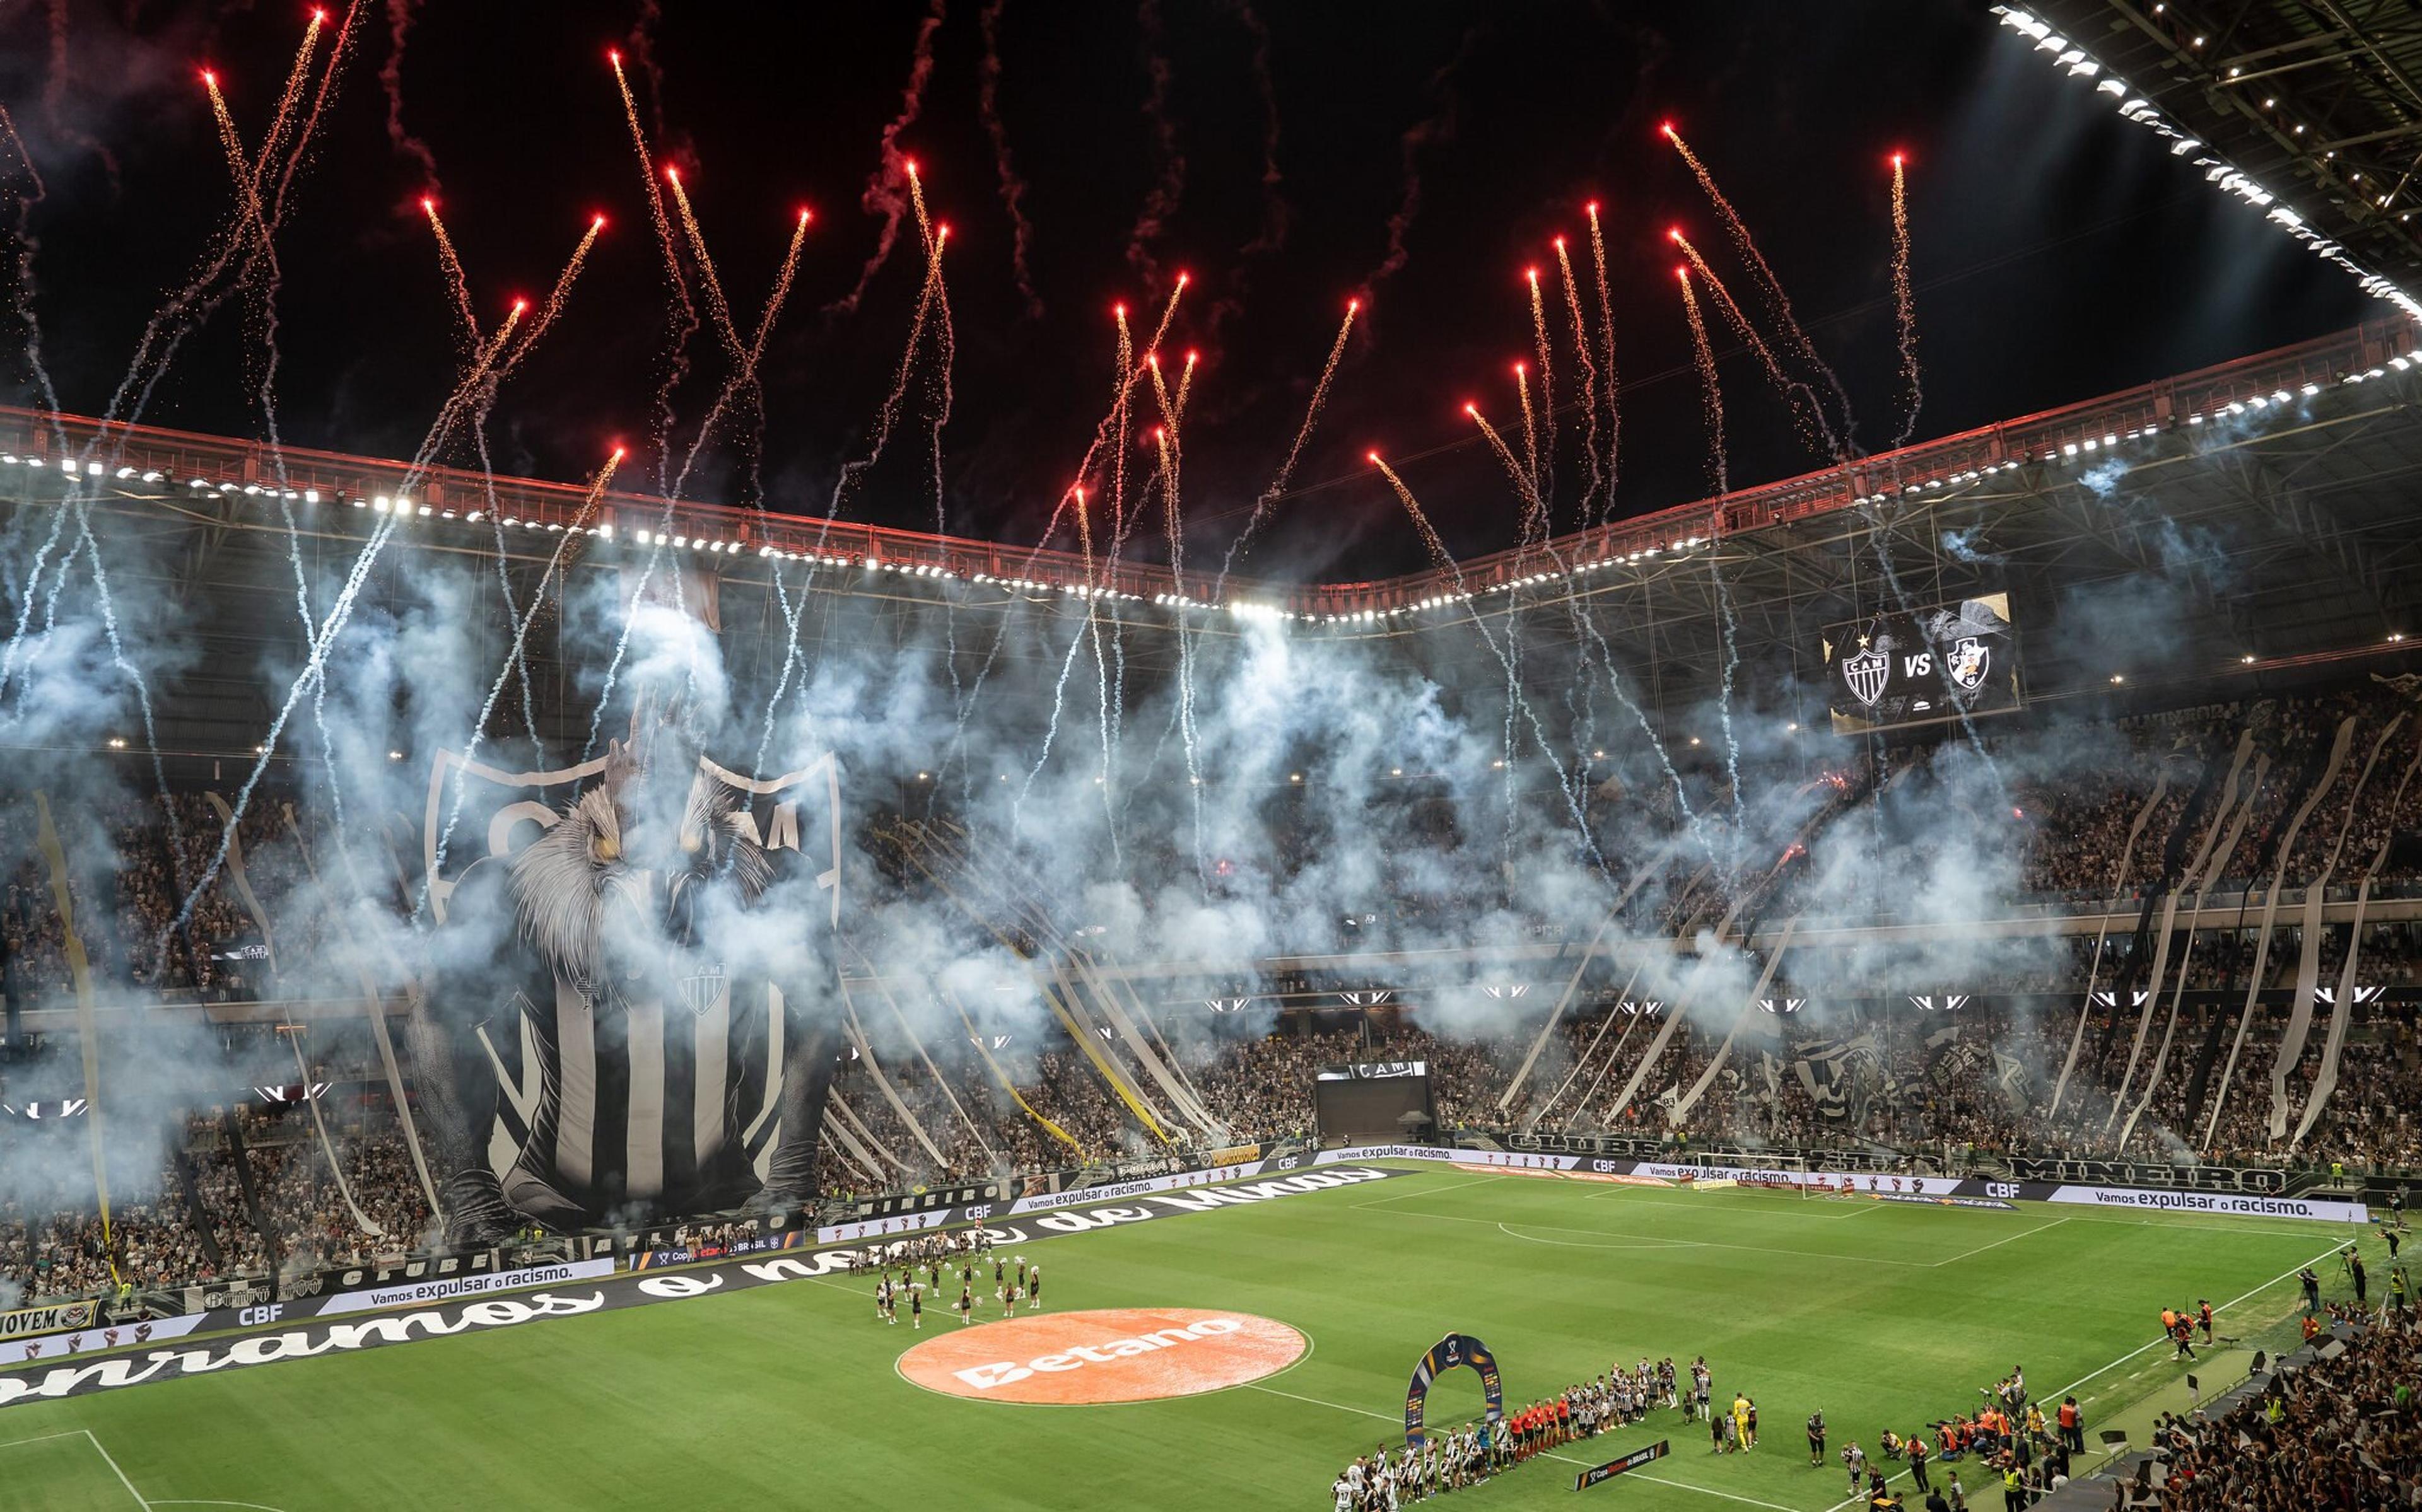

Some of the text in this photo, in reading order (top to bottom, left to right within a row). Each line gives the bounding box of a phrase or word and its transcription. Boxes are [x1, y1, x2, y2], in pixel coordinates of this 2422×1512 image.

[1850, 659, 1882, 672] CAM
[1904, 653, 1931, 678] VS
[1359, 1062, 1405, 1078] CAM
[1278, 1156, 1298, 1170] CBF
[1337, 1151, 1360, 1160] Vamos
[1362, 1144, 1407, 1159] expulsar
[1415, 1147, 1453, 1160] racismo.
[1593, 1159, 1616, 1173] CBF
[1649, 1166, 1676, 1177] Vamos
[1740, 1169, 1792, 1184] racismo.
[2007, 1157, 2287, 1194] MINEIRO
[858, 1186, 998, 1215] MINEIRO
[1027, 1198, 1055, 1210] Vamos
[1055, 1189, 1103, 1206] expulsar
[1111, 1182, 1154, 1196] racismo.
[1036, 1207, 1154, 1232] de
[1142, 1166, 1389, 1211] Minas
[1985, 1182, 2020, 1199] CBF
[965, 1204, 992, 1221] CBF
[2095, 1191, 2313, 1216] Vamos expulsar o racismo.
[672, 1252, 689, 1261] Cop
[738, 1240, 766, 1252] BRSIL
[371, 1267, 573, 1305] Vamos expulsar o racismo.
[239, 1303, 284, 1326] CBF
[951, 1319, 1243, 1389] Betano
